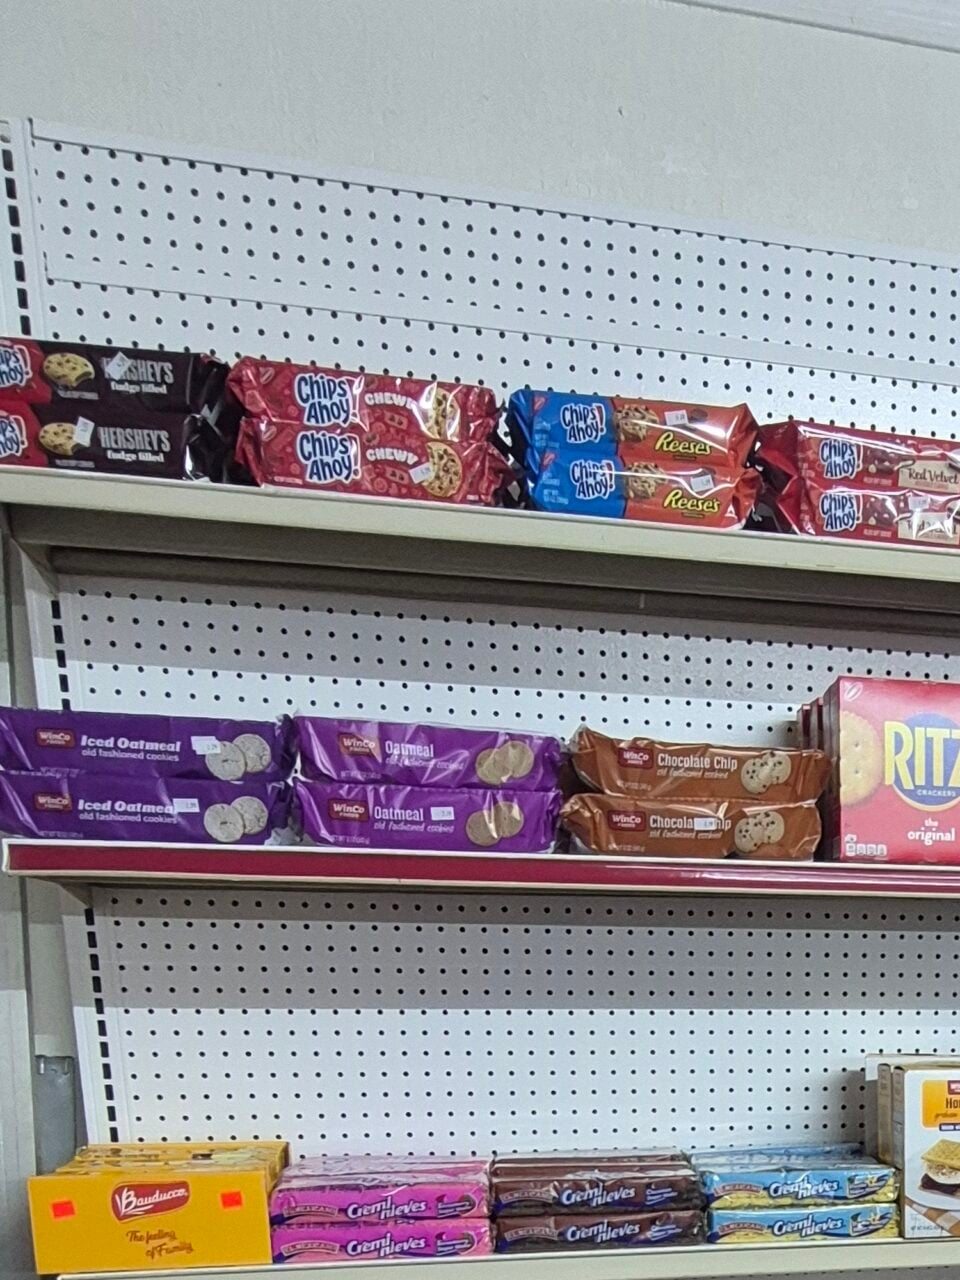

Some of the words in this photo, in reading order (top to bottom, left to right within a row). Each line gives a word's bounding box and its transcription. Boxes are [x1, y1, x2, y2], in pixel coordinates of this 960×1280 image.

[296, 374, 349, 404] Chips
[561, 404, 596, 426] Chips
[98, 428, 171, 453] HERSHEY'S
[298, 433, 351, 464] Chips
[366, 447, 419, 465] CHEWY
[820, 439, 856, 465] Chips
[571, 461, 606, 484] Chips
[664, 489, 721, 512] Reese's
[820, 492, 855, 519] Chips
[81, 735, 114, 748] Iced
[117, 737, 181, 752] Oatmeal
[385, 740, 434, 757] Oatmeal
[658, 753, 711, 769] Chocolate
[713, 755, 739, 771] Chip
[78, 798, 112, 810] Iced
[374, 807, 424, 821] Oatmeal
[650, 815, 694, 829] Chocola
[925, 818, 938, 827] the
[907, 826, 956, 846] original
[115, 1186, 189, 1212] Bauducco
[126, 1229, 145, 1242] The
